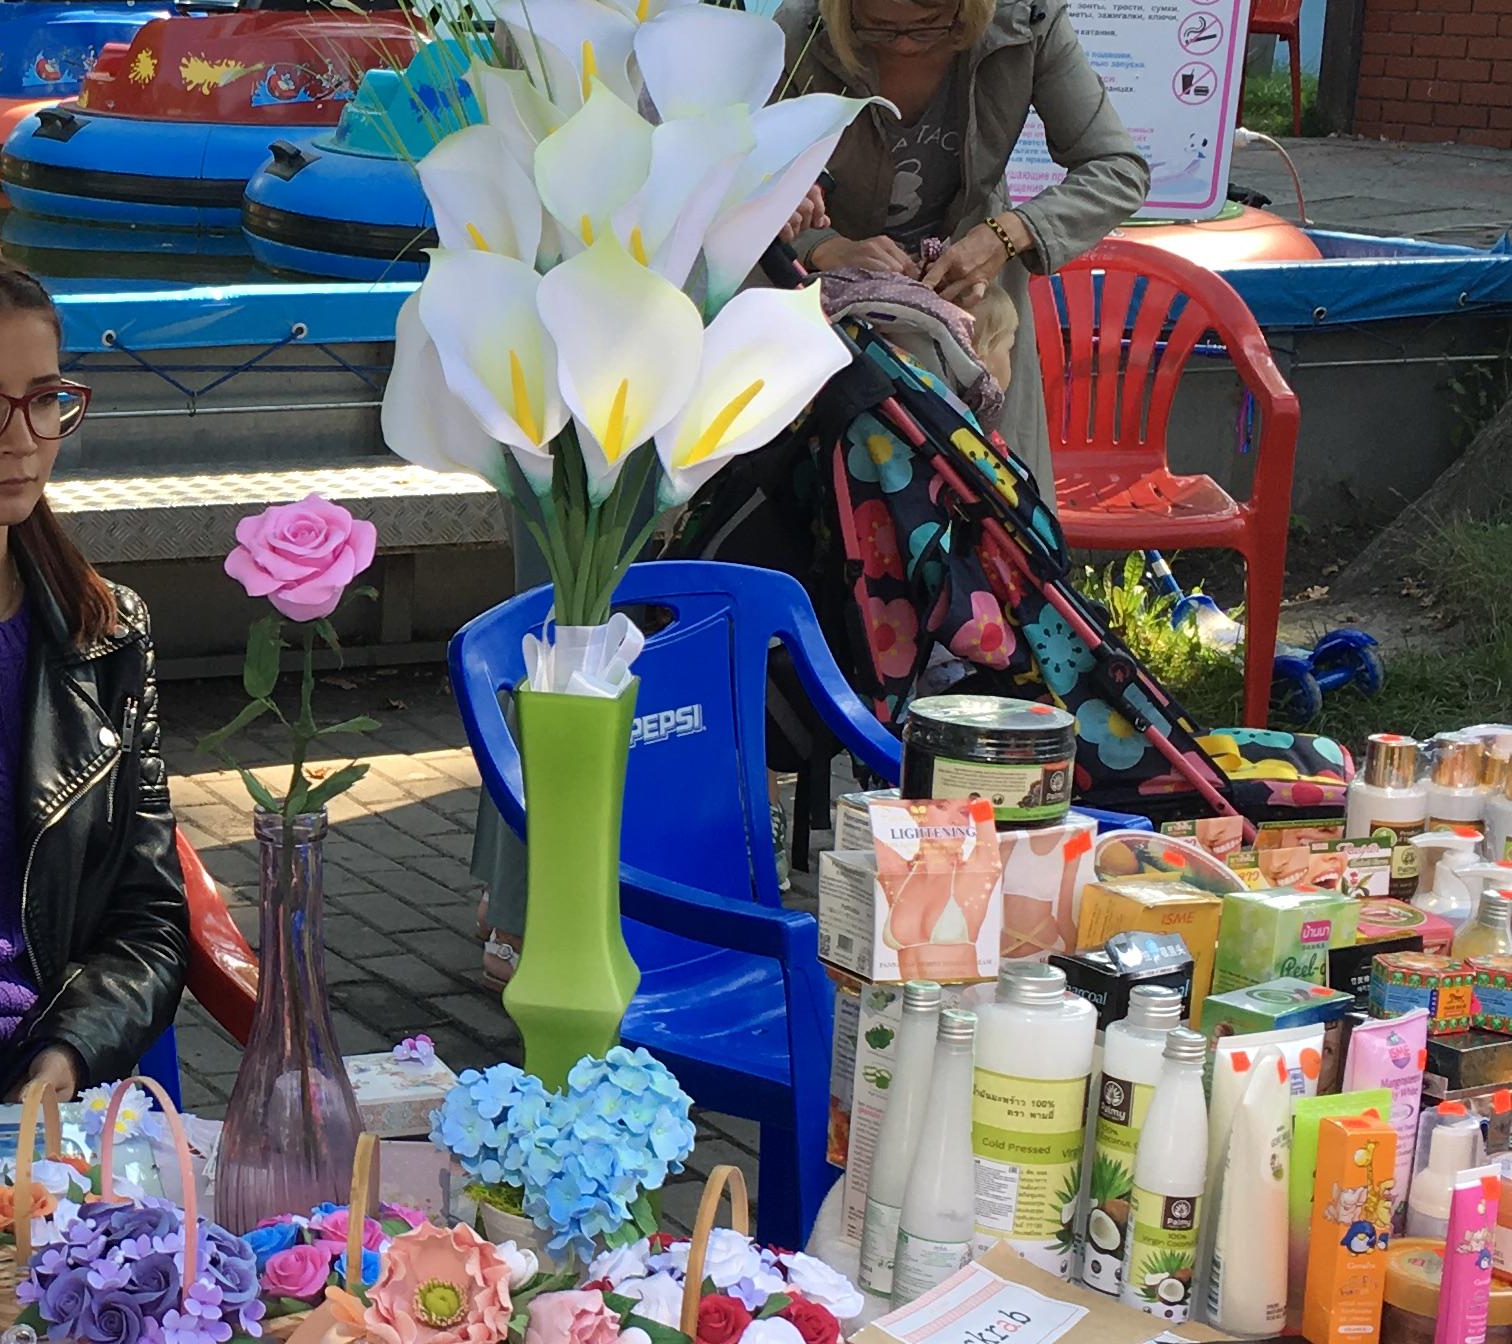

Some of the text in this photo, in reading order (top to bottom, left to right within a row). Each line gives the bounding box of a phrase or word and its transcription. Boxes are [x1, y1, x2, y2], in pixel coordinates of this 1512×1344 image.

[630, 704, 704, 747] PEPSI
[890, 827, 976, 839] LIGHTENING
[1161, 912, 1194, 926] ISME
[1389, 1045, 1410, 1058] ISME
[1032, 1100, 1055, 1108] 100%
[983, 1138, 1051, 1154] Cold Pressed
